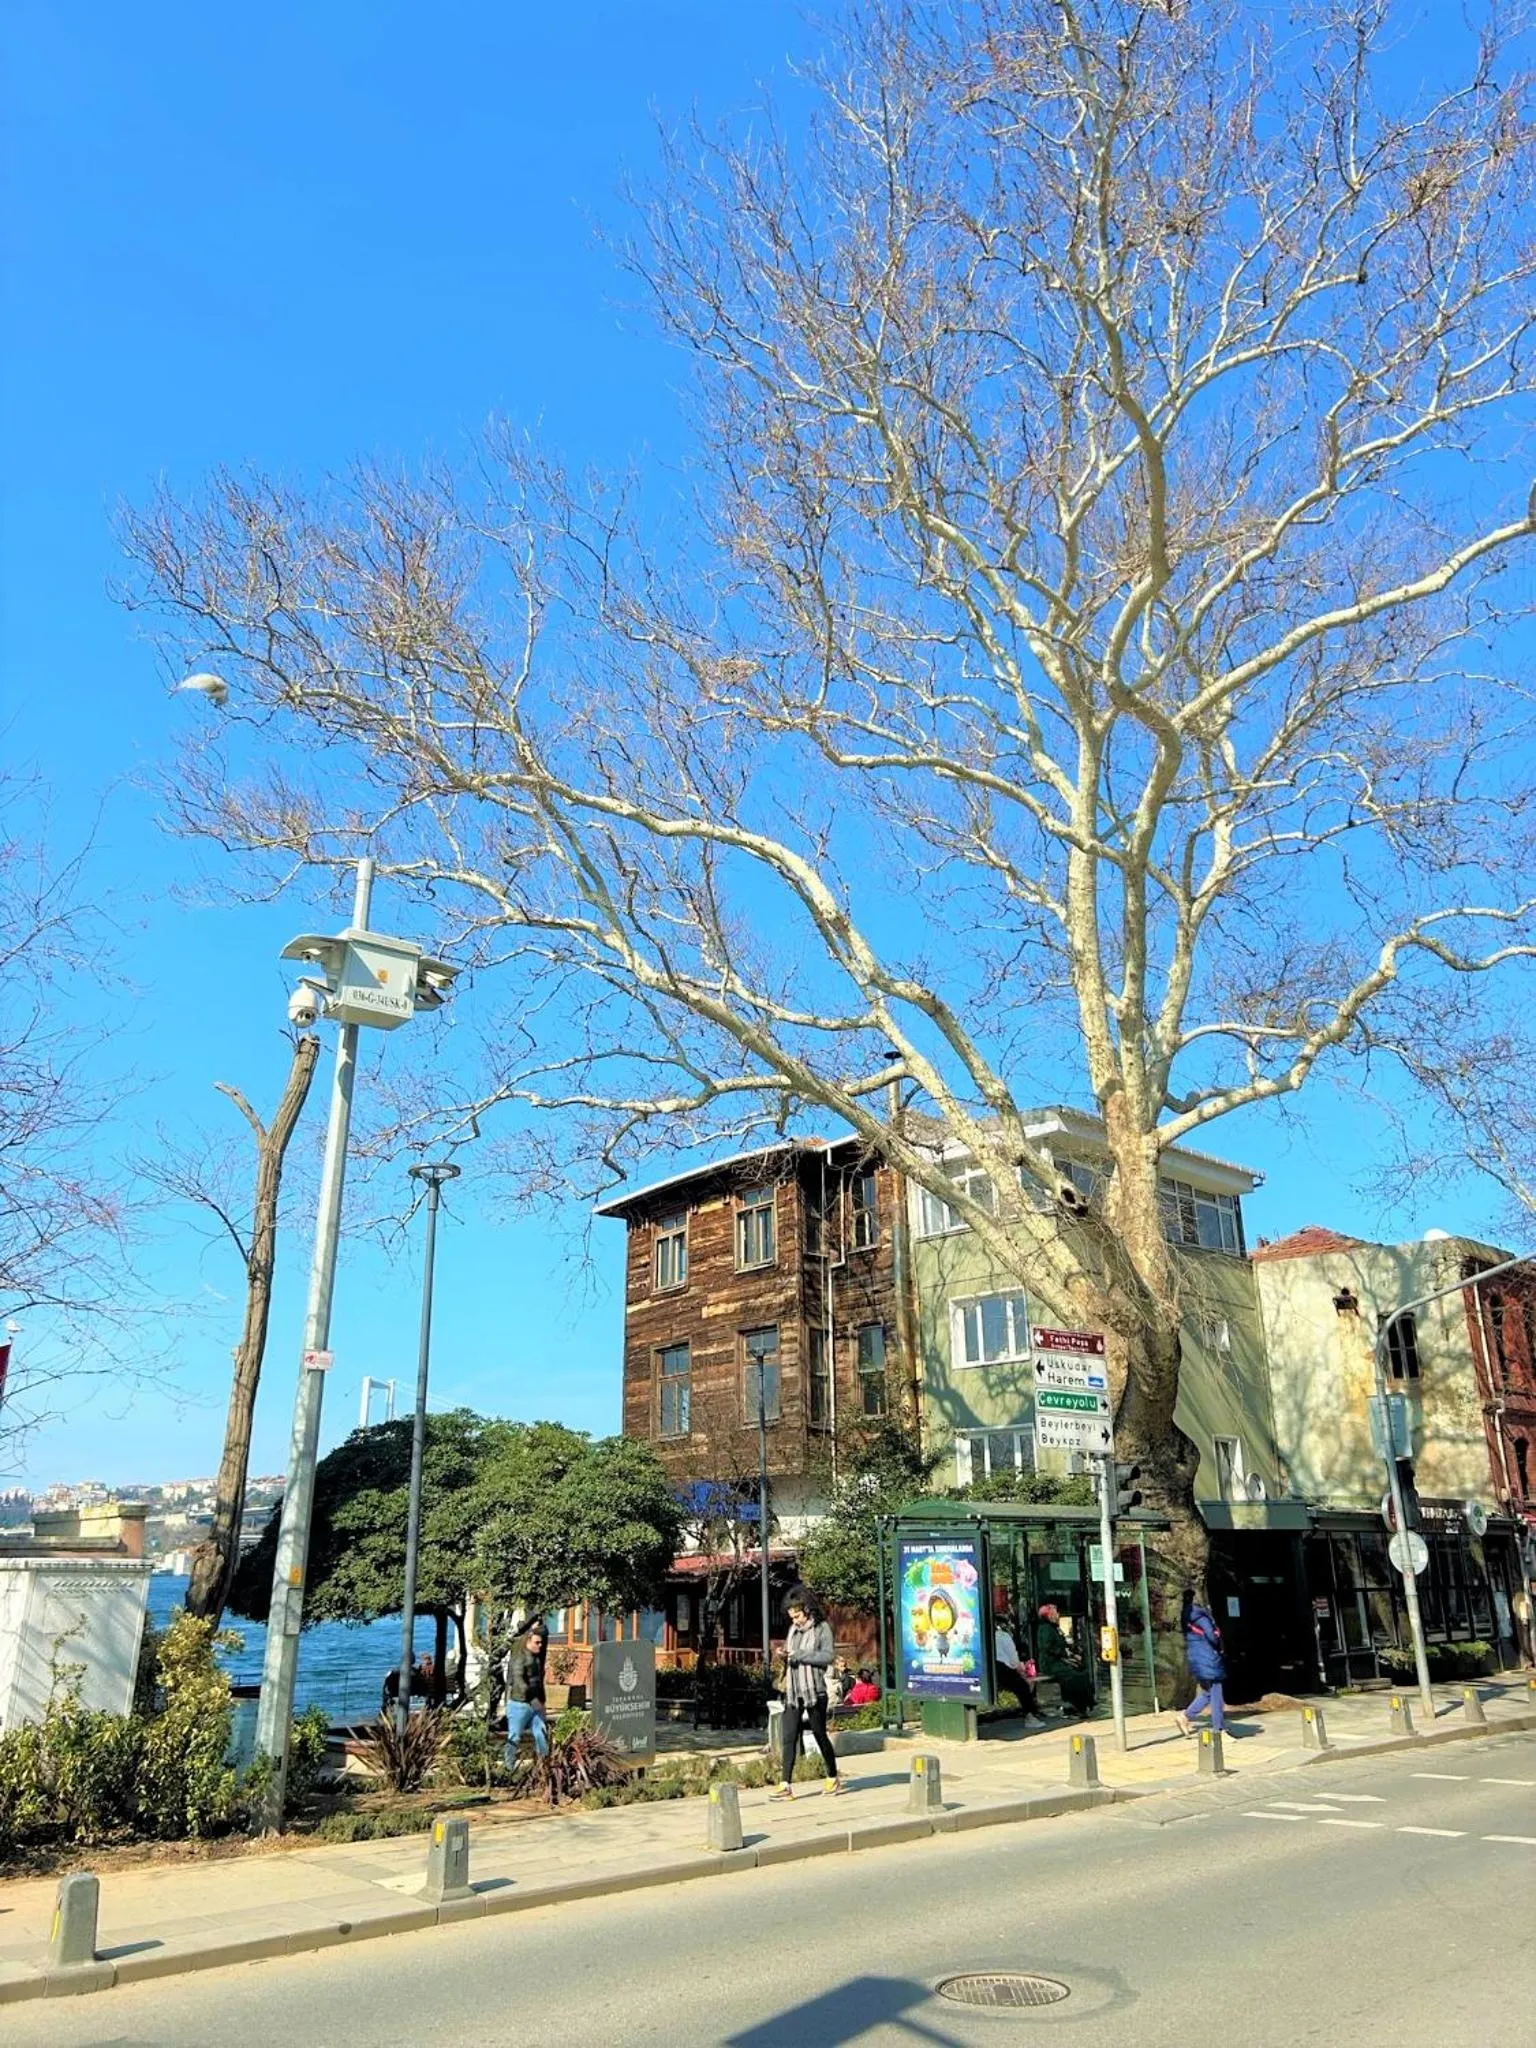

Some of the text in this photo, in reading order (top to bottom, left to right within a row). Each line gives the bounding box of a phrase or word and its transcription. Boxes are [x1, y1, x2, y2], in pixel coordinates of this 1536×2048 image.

[1047, 1371, 1085, 1385] Harem
[1039, 1391, 1096, 1410] Çevreyolu
[1040, 1416, 1096, 1433] Beylerbeyi
[1041, 1432, 1081, 1449] Beykoz
